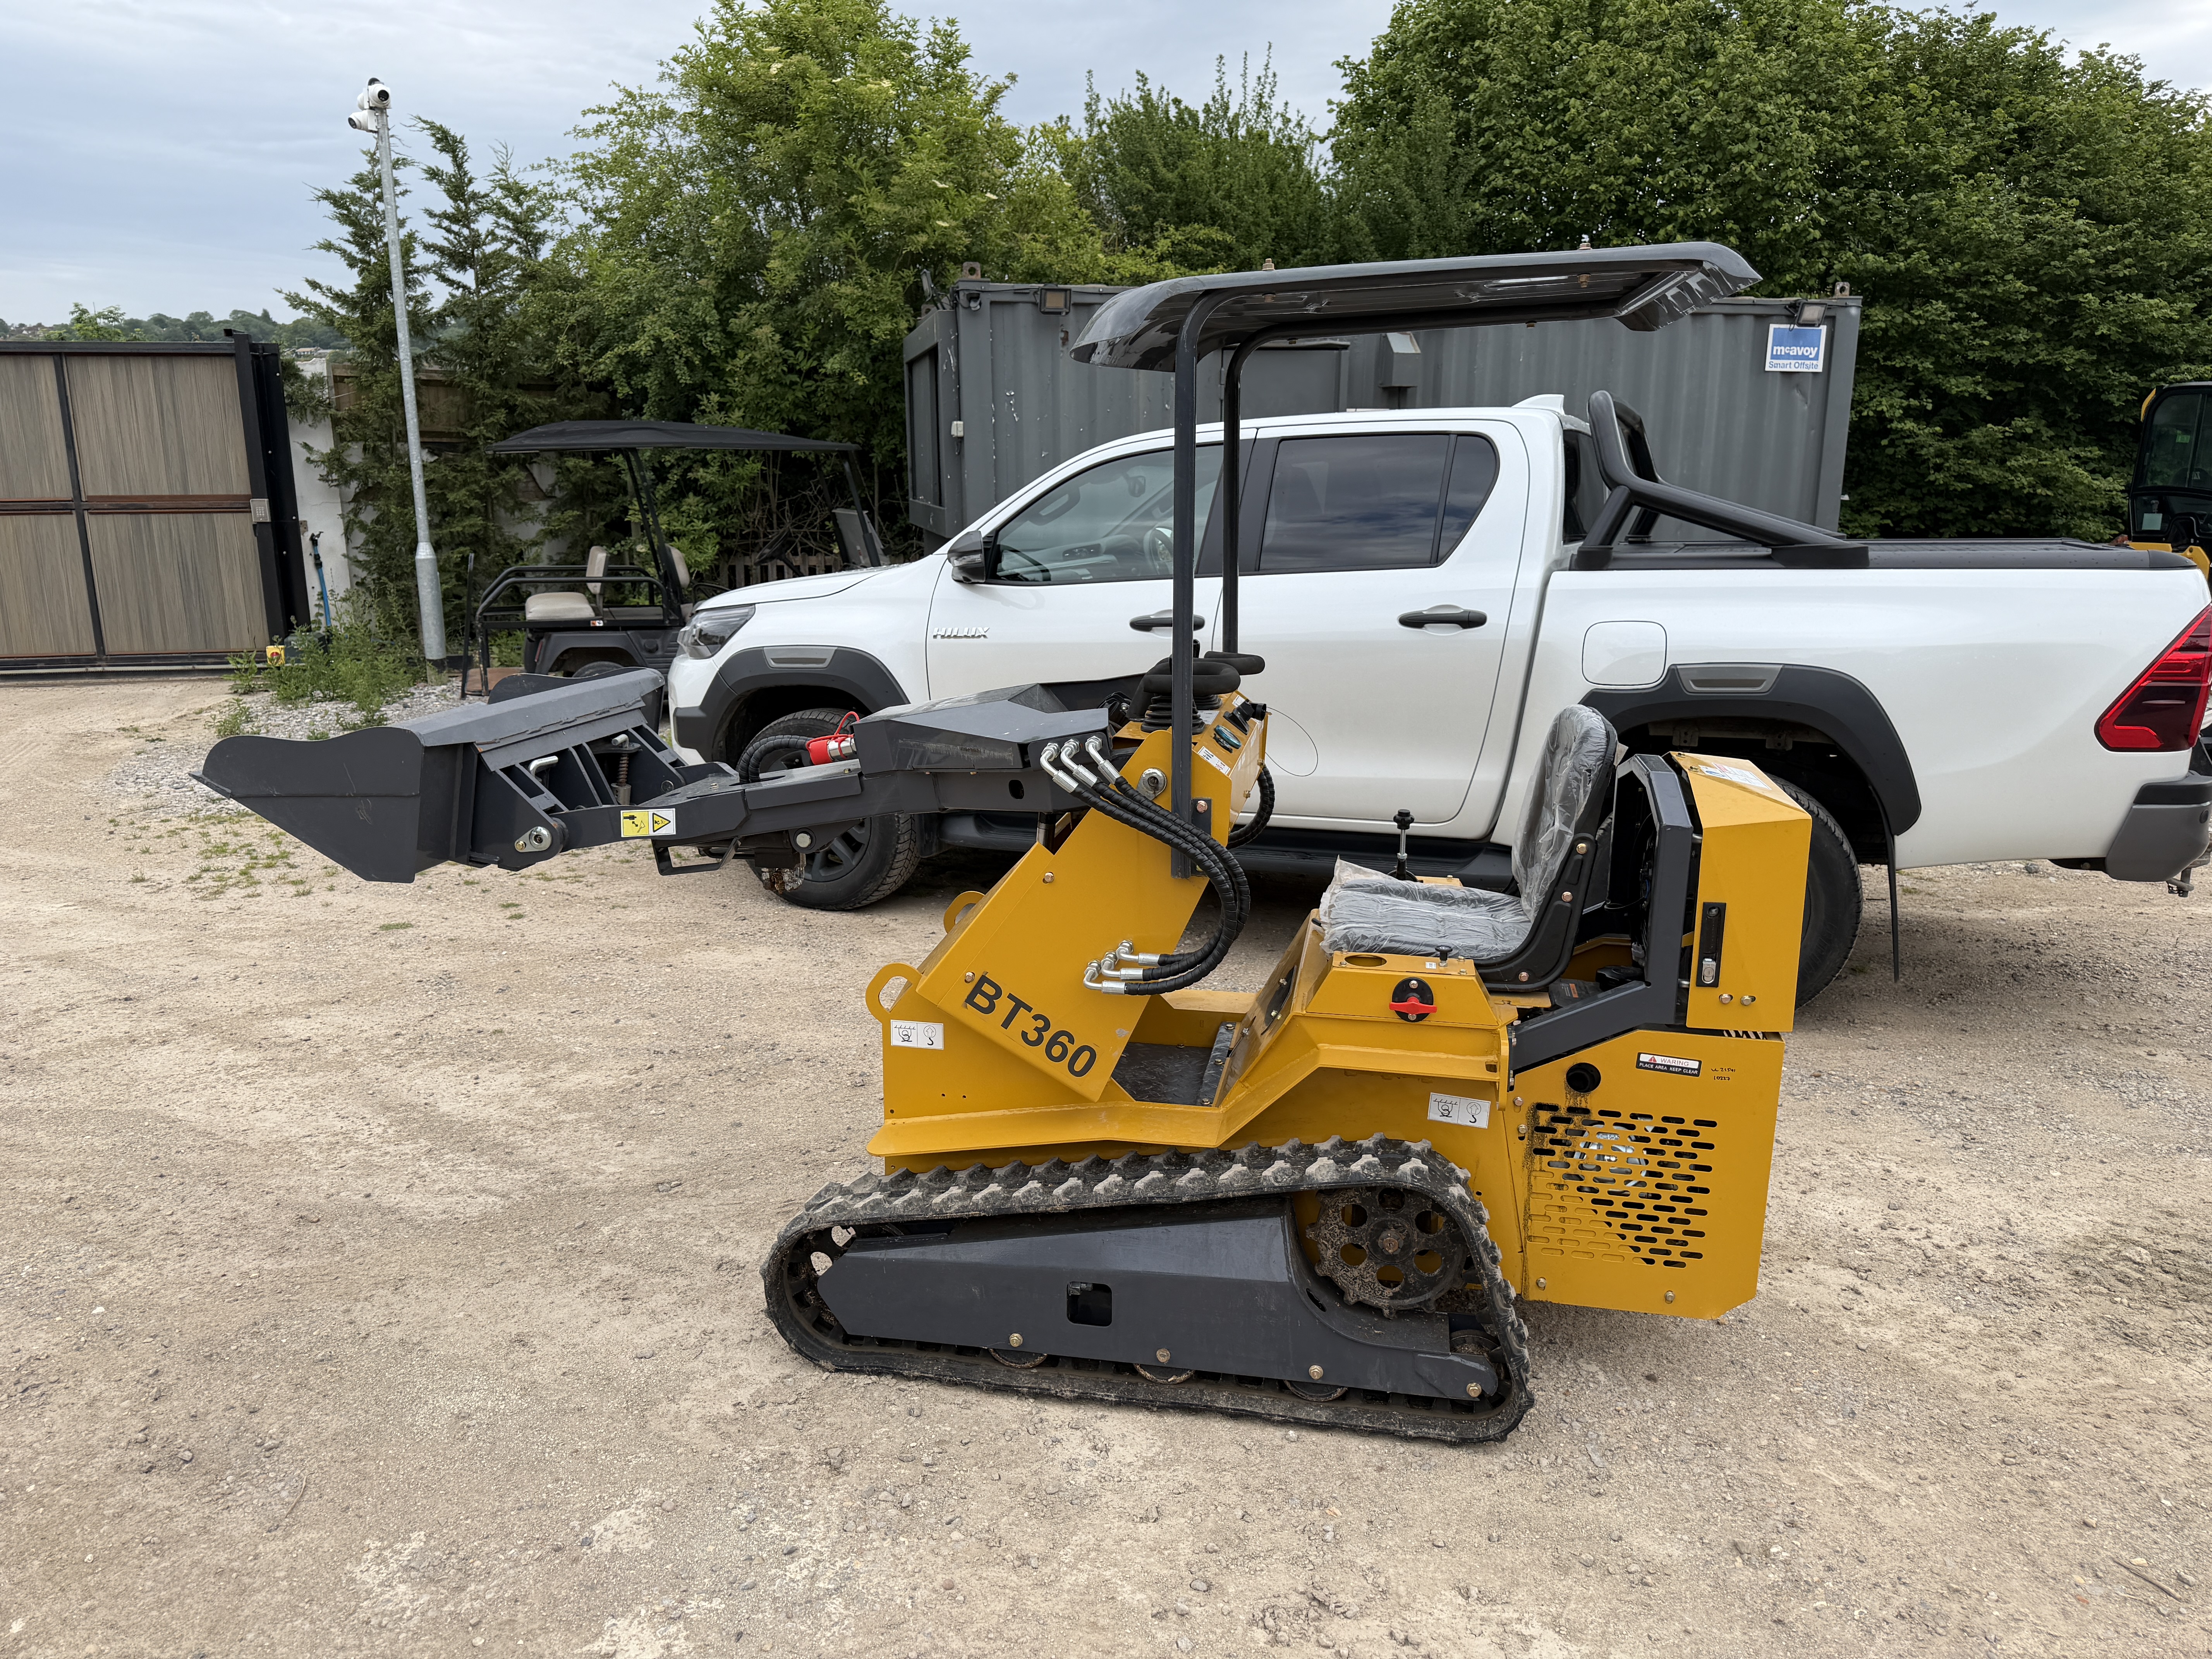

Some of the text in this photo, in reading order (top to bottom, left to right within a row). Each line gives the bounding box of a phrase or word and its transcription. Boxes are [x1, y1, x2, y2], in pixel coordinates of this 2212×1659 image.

[1794, 362, 1819, 370] Offsite
[933, 627, 990, 639] HILUX
[965, 974, 1097, 1078] BT360
[1661, 1058, 1689, 1066] WARING
